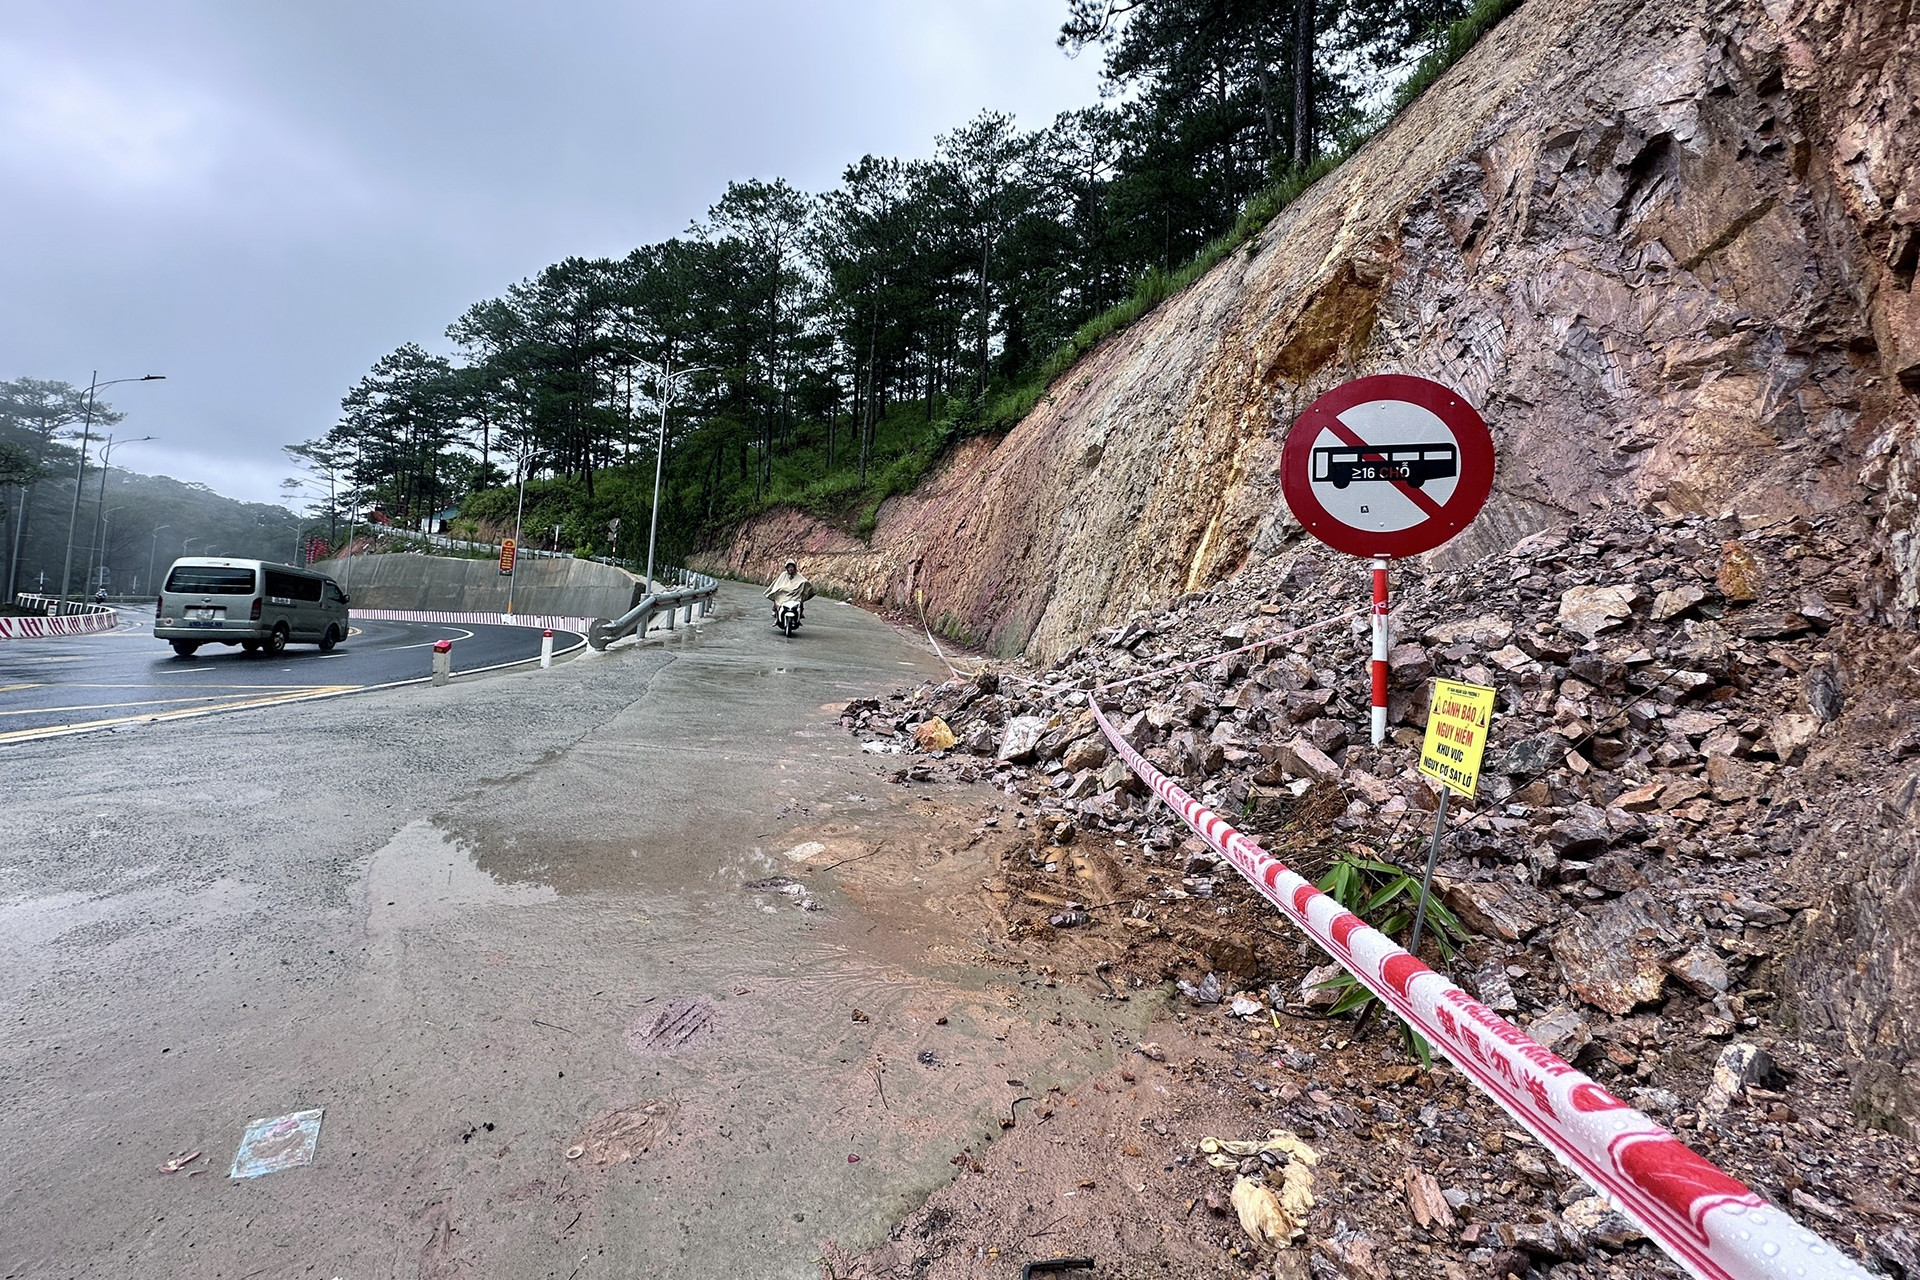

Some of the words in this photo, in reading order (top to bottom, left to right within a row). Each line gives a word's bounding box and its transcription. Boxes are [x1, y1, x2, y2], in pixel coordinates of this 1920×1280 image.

[1442, 696, 1461, 718] CẢNH
[1461, 702, 1476, 722] BÁO
[1436, 721, 1455, 740] NGUY
[1454, 724, 1474, 747] HIỂM
[1437, 743, 1450, 757] KHU
[1451, 748, 1464, 763] VỰC
[1424, 756, 1439, 771] NGUY
[1440, 763, 1449, 776] CƠ
[1449, 768, 1462, 784] SẠT
